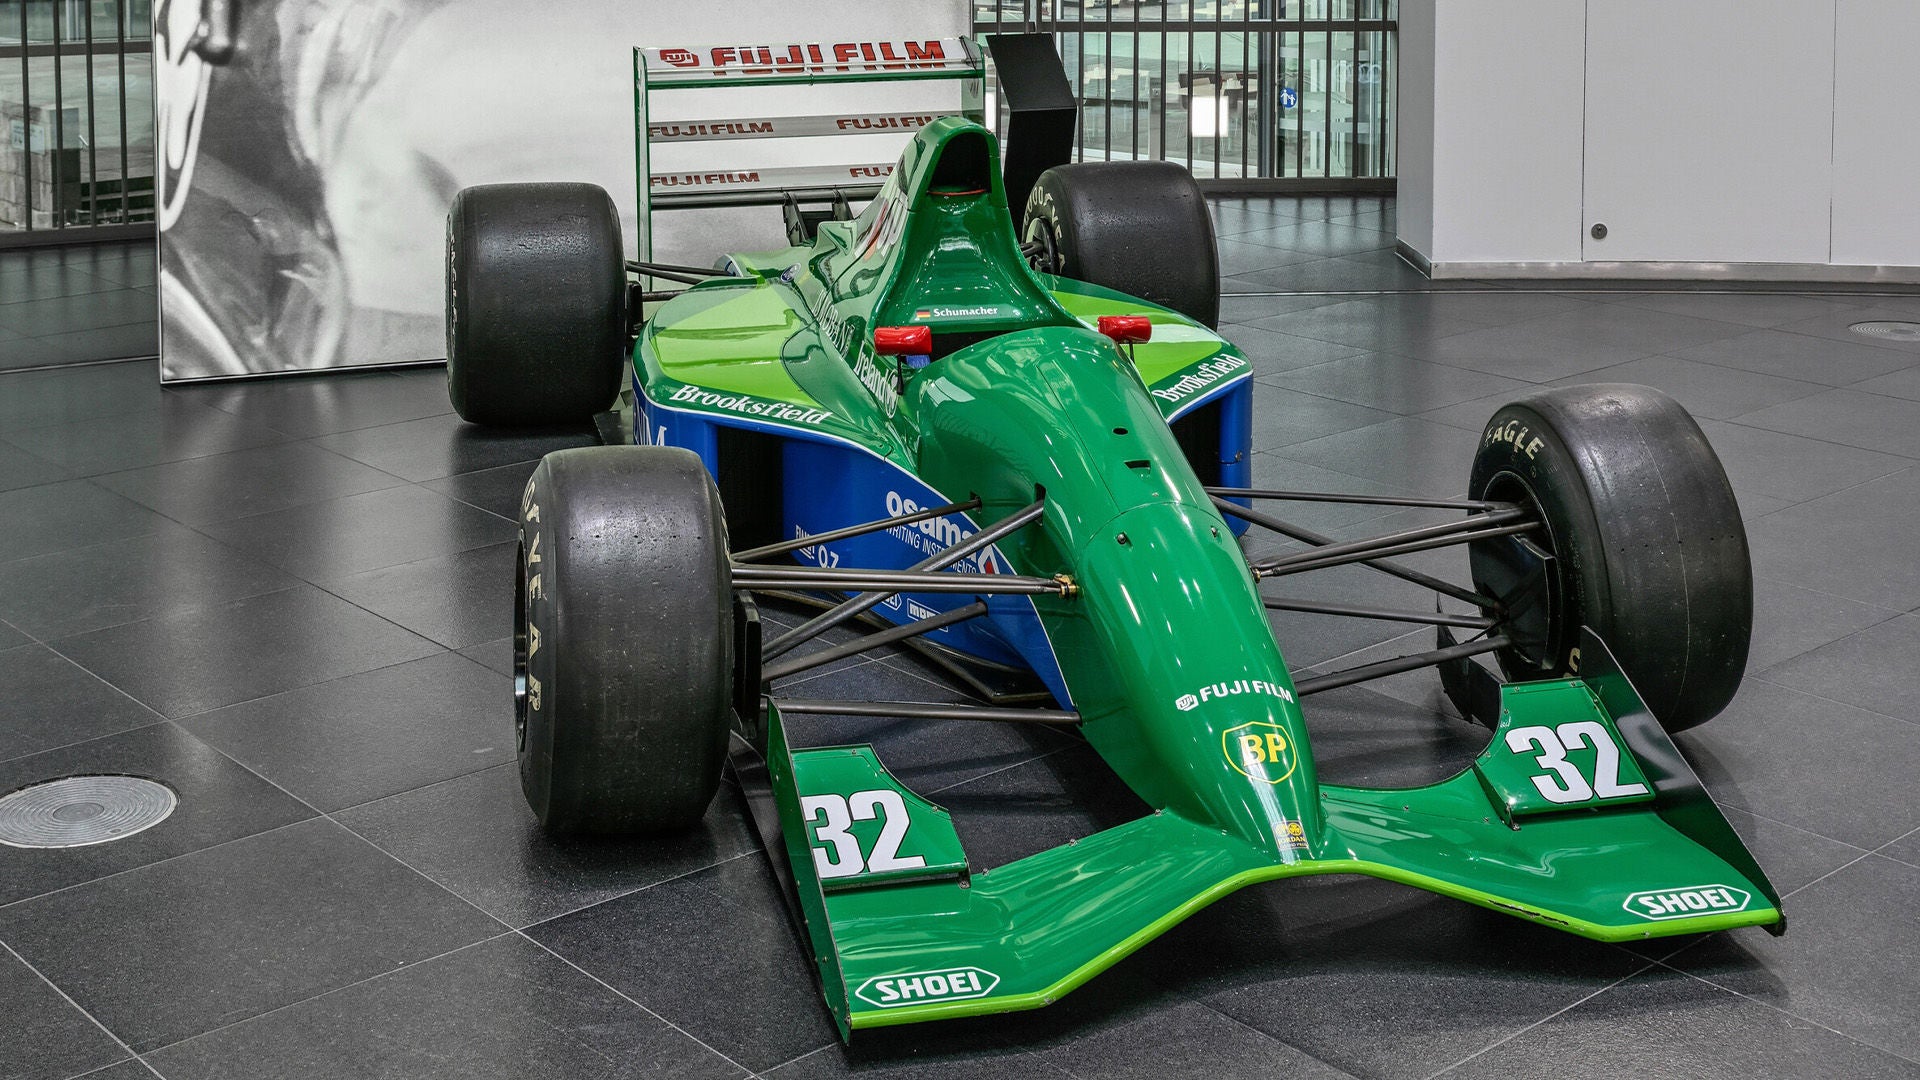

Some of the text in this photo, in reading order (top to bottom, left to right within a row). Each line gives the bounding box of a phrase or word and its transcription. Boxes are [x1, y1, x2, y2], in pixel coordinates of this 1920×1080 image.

[933, 306, 998, 318] Schumacher
[1151, 353, 1247, 403] Brooksfield
[669, 384, 833, 425] Brooksfield
[1238, 733, 1288, 768] BP
[1504, 720, 1650, 804] 32
[800, 789, 928, 879] 32
[1637, 888, 1739, 915] SHOEI
[874, 971, 982, 1002] SHOEI
